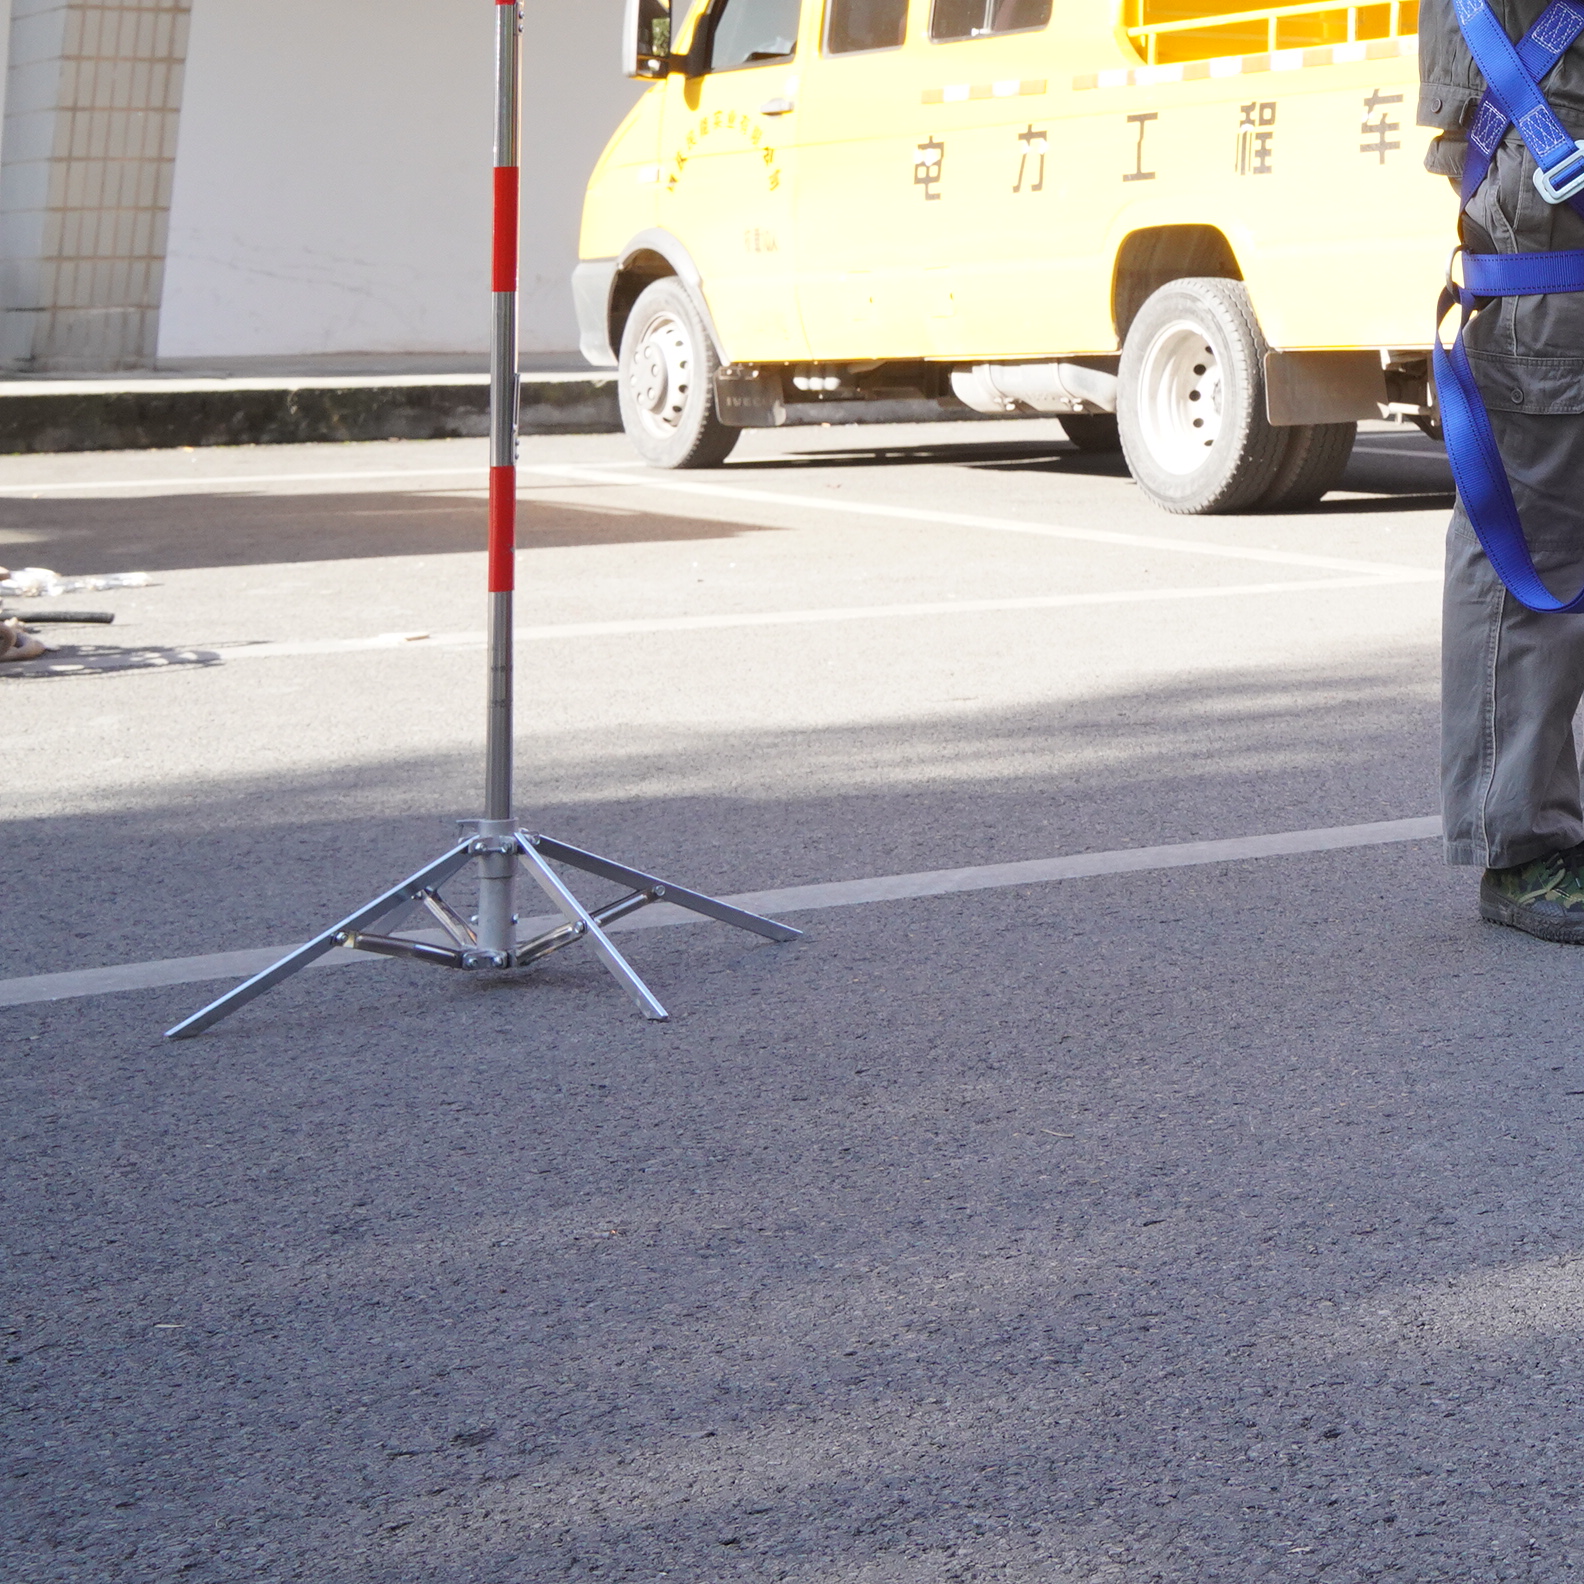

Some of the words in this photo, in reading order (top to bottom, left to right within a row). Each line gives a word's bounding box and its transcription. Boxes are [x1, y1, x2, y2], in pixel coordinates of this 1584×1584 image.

[913, 89, 1404, 201] 电力工程车
